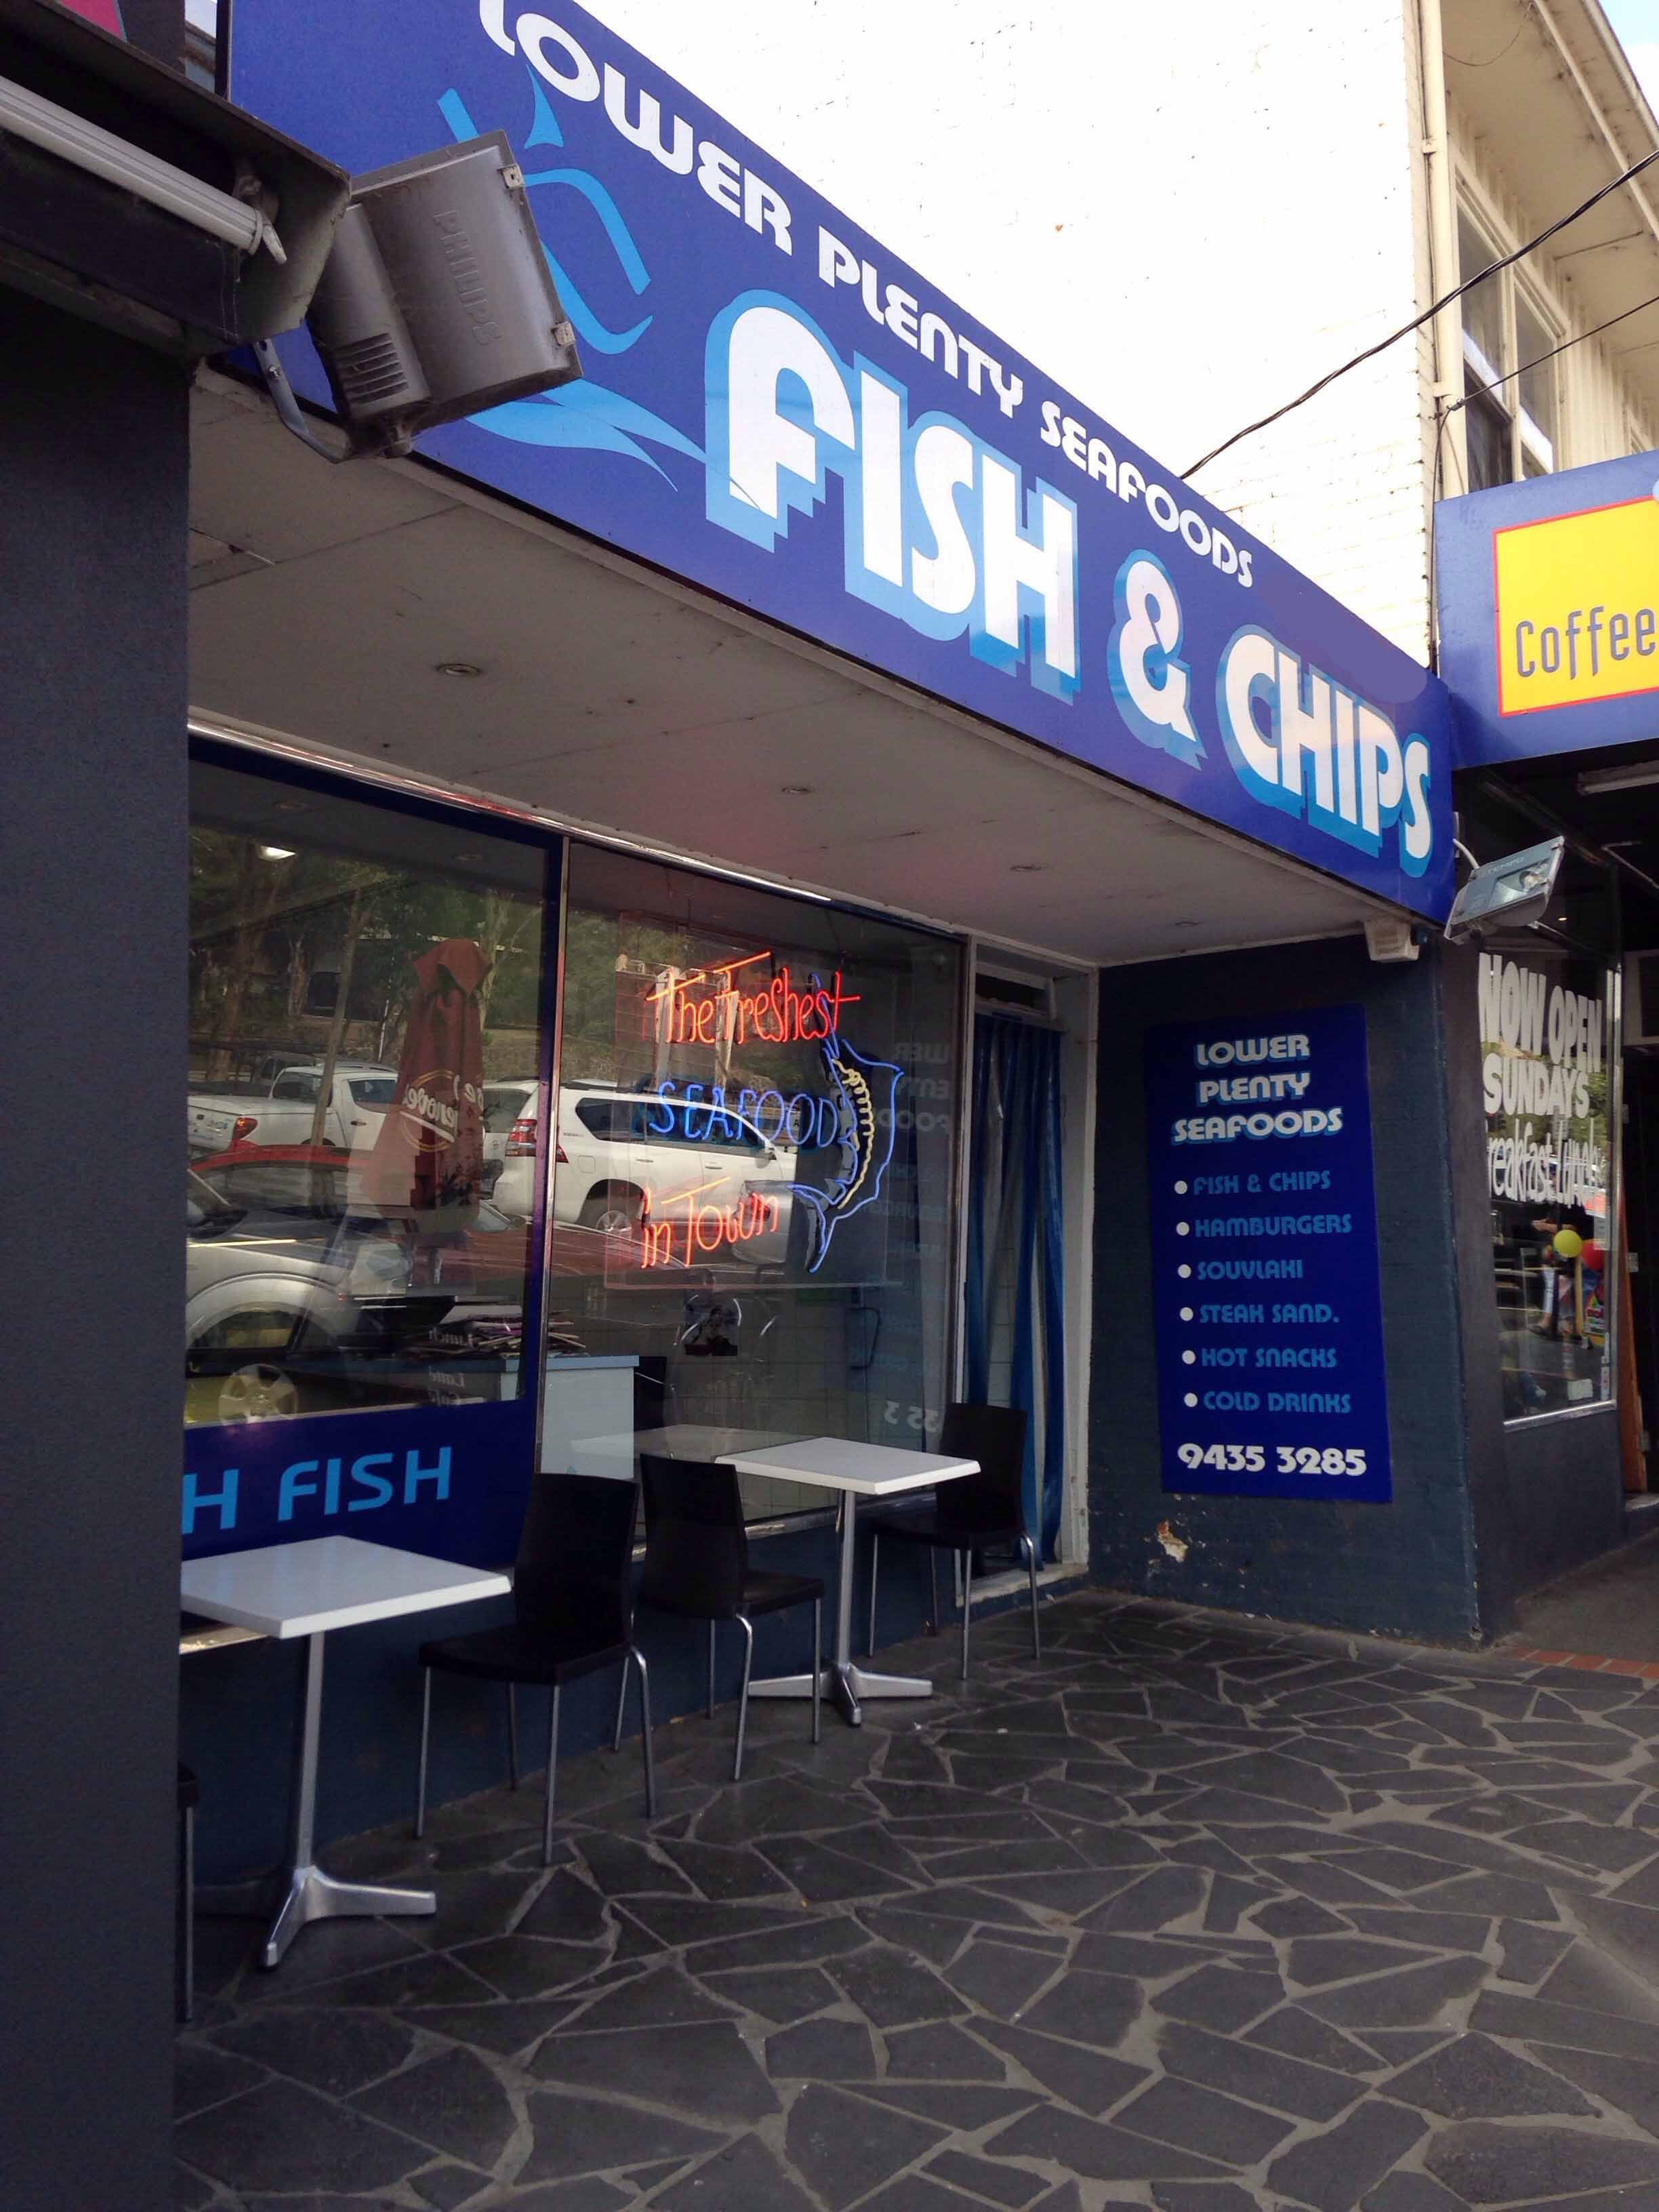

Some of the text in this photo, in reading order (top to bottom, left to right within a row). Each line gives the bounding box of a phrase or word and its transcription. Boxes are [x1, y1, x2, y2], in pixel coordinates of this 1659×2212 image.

[433, 209, 501, 344] PHILIPS
[479, 0, 1253, 588] LOWER PLENTY SEAFOODS
[725, 304, 1433, 863] FISH & CHIPS
[1515, 605, 1657, 680] Coffee
[646, 970, 715, 1044] The
[1477, 952, 1603, 1073] NOW OPEN
[1195, 1034, 1310, 1067] LOWER
[1197, 1072, 1311, 1105] PLENTY
[1483, 1052, 1591, 1119] SUNDAYS
[648, 1080, 838, 1149] SEAFOOD
[1172, 1107, 1343, 1144] SEAFOODS
[1193, 1170, 1331, 1195] FISH & CHIPS
[1485, 1118, 1553, 1204] reakfast
[1195, 1214, 1353, 1237] HAMBURGERS
[1197, 1260, 1303, 1280] SOUVLAKI
[1200, 1304, 1340, 1323] STEAK SAND.
[1201, 1348, 1337, 1368] HOT SNACKS
[1203, 1391, 1352, 1413] COLD DRINKS
[277, 1446, 453, 1522] FISH
[1177, 1442, 1367, 1477] 9435 3285
